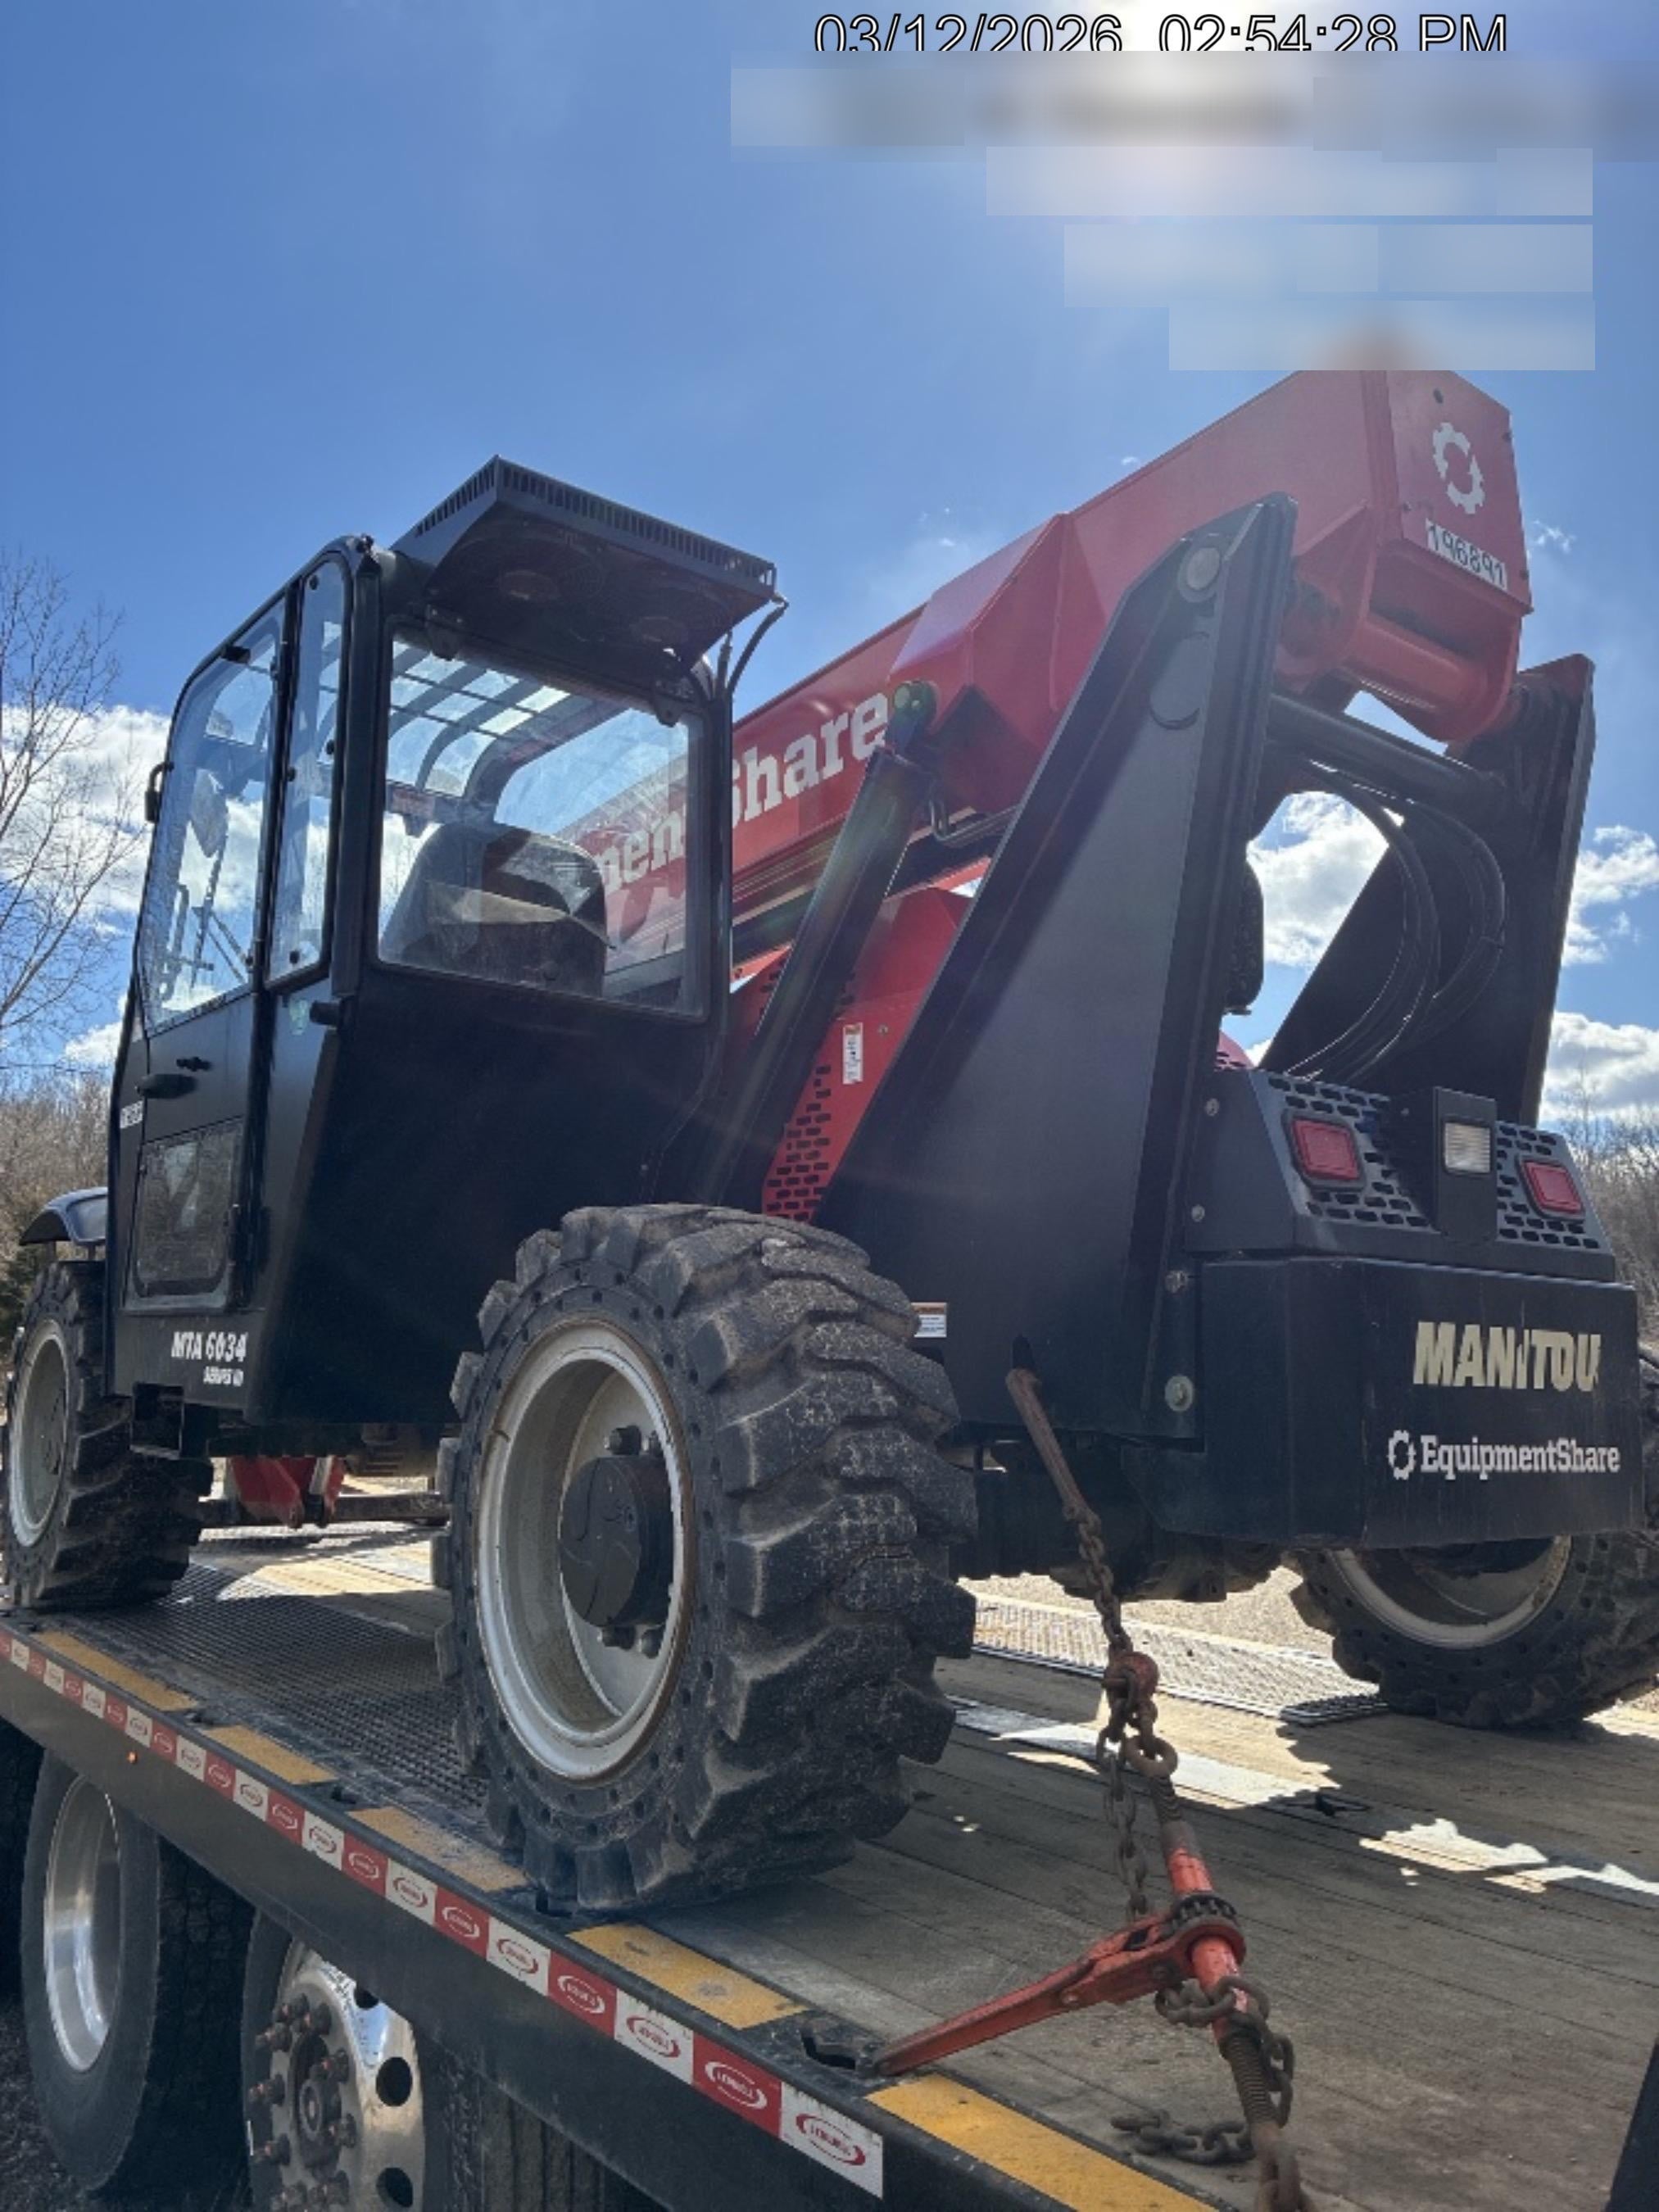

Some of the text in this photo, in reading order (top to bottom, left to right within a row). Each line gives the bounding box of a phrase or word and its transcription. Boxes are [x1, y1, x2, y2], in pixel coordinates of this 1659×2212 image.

[1428, 524, 1505, 588] 196891
[170, 1331, 248, 1362] MTA 6034
[1413, 1321, 1602, 1392] MANITOU
[1420, 1435, 1620, 1480] EquipmentShare
